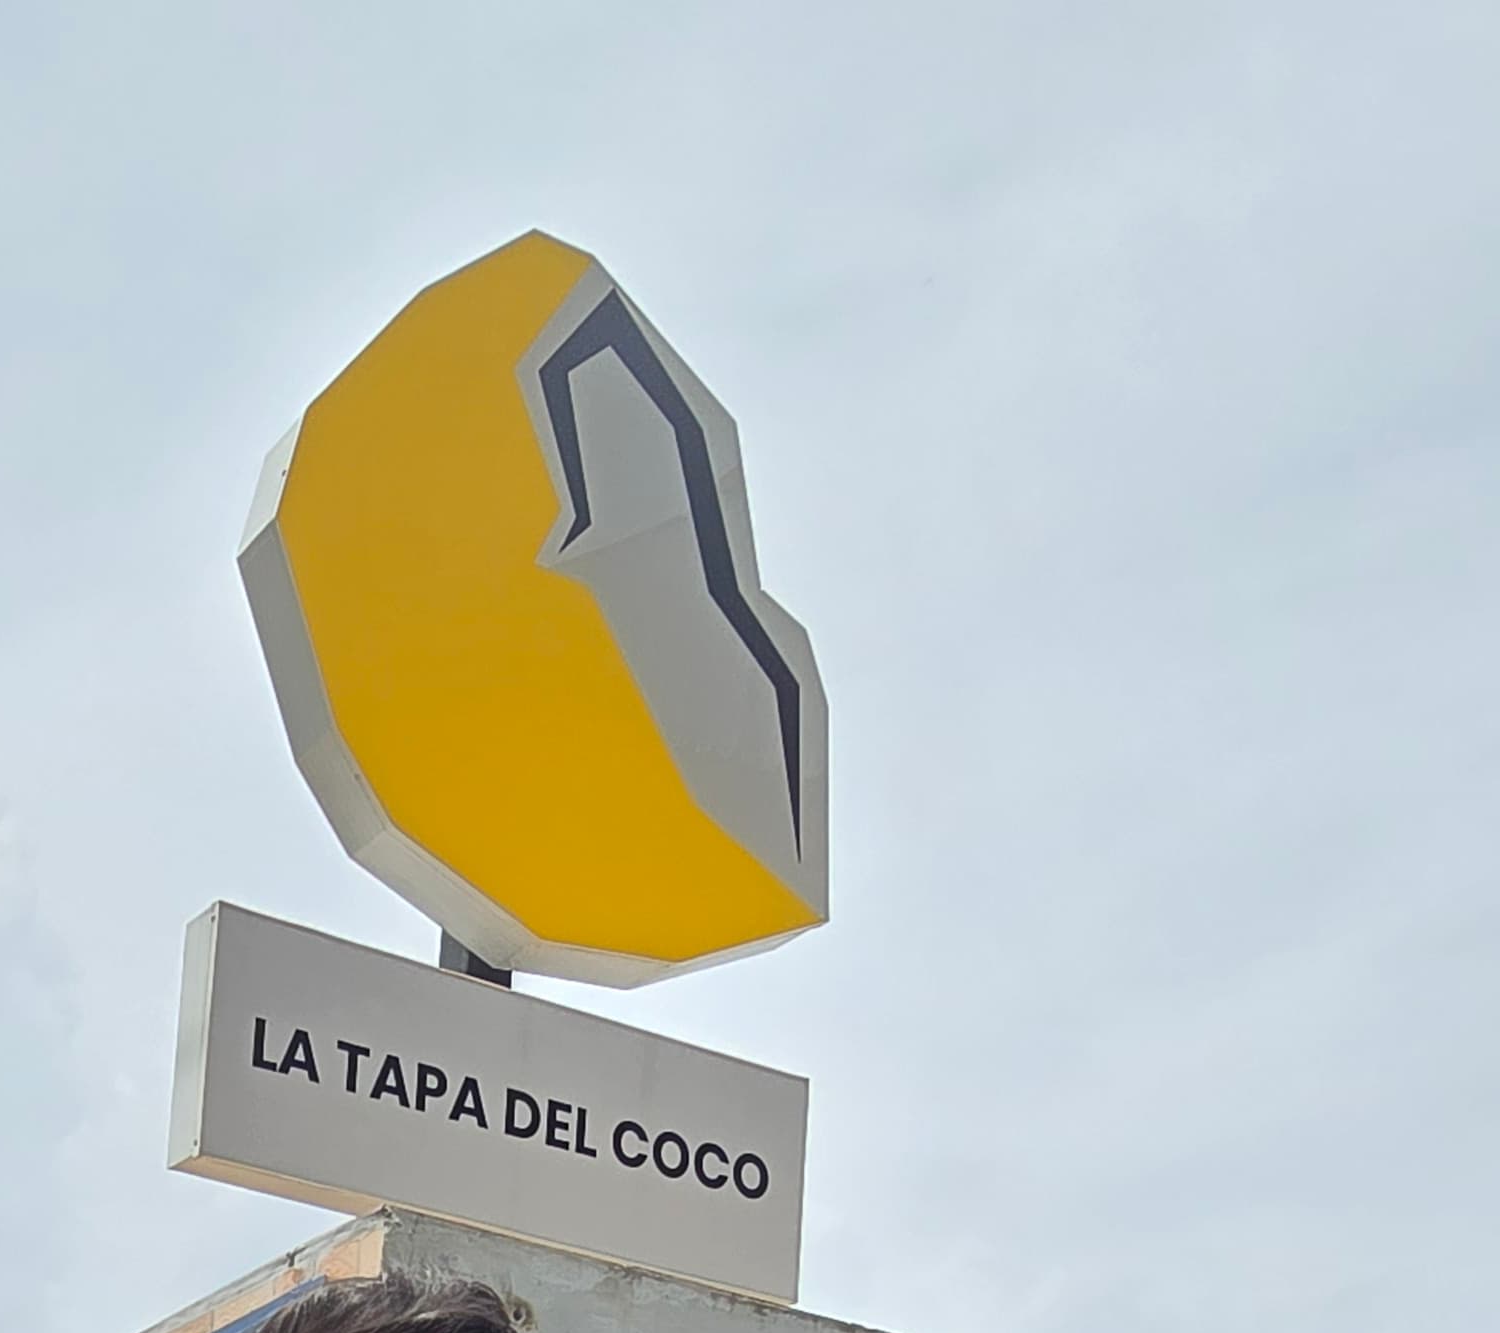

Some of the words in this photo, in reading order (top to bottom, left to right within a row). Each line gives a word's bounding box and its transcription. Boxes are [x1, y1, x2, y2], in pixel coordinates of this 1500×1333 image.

[252, 1017, 320, 1084] LA
[336, 1039, 489, 1130] TAPA
[504, 1087, 598, 1159] DEL
[612, 1119, 770, 1200] COCO
